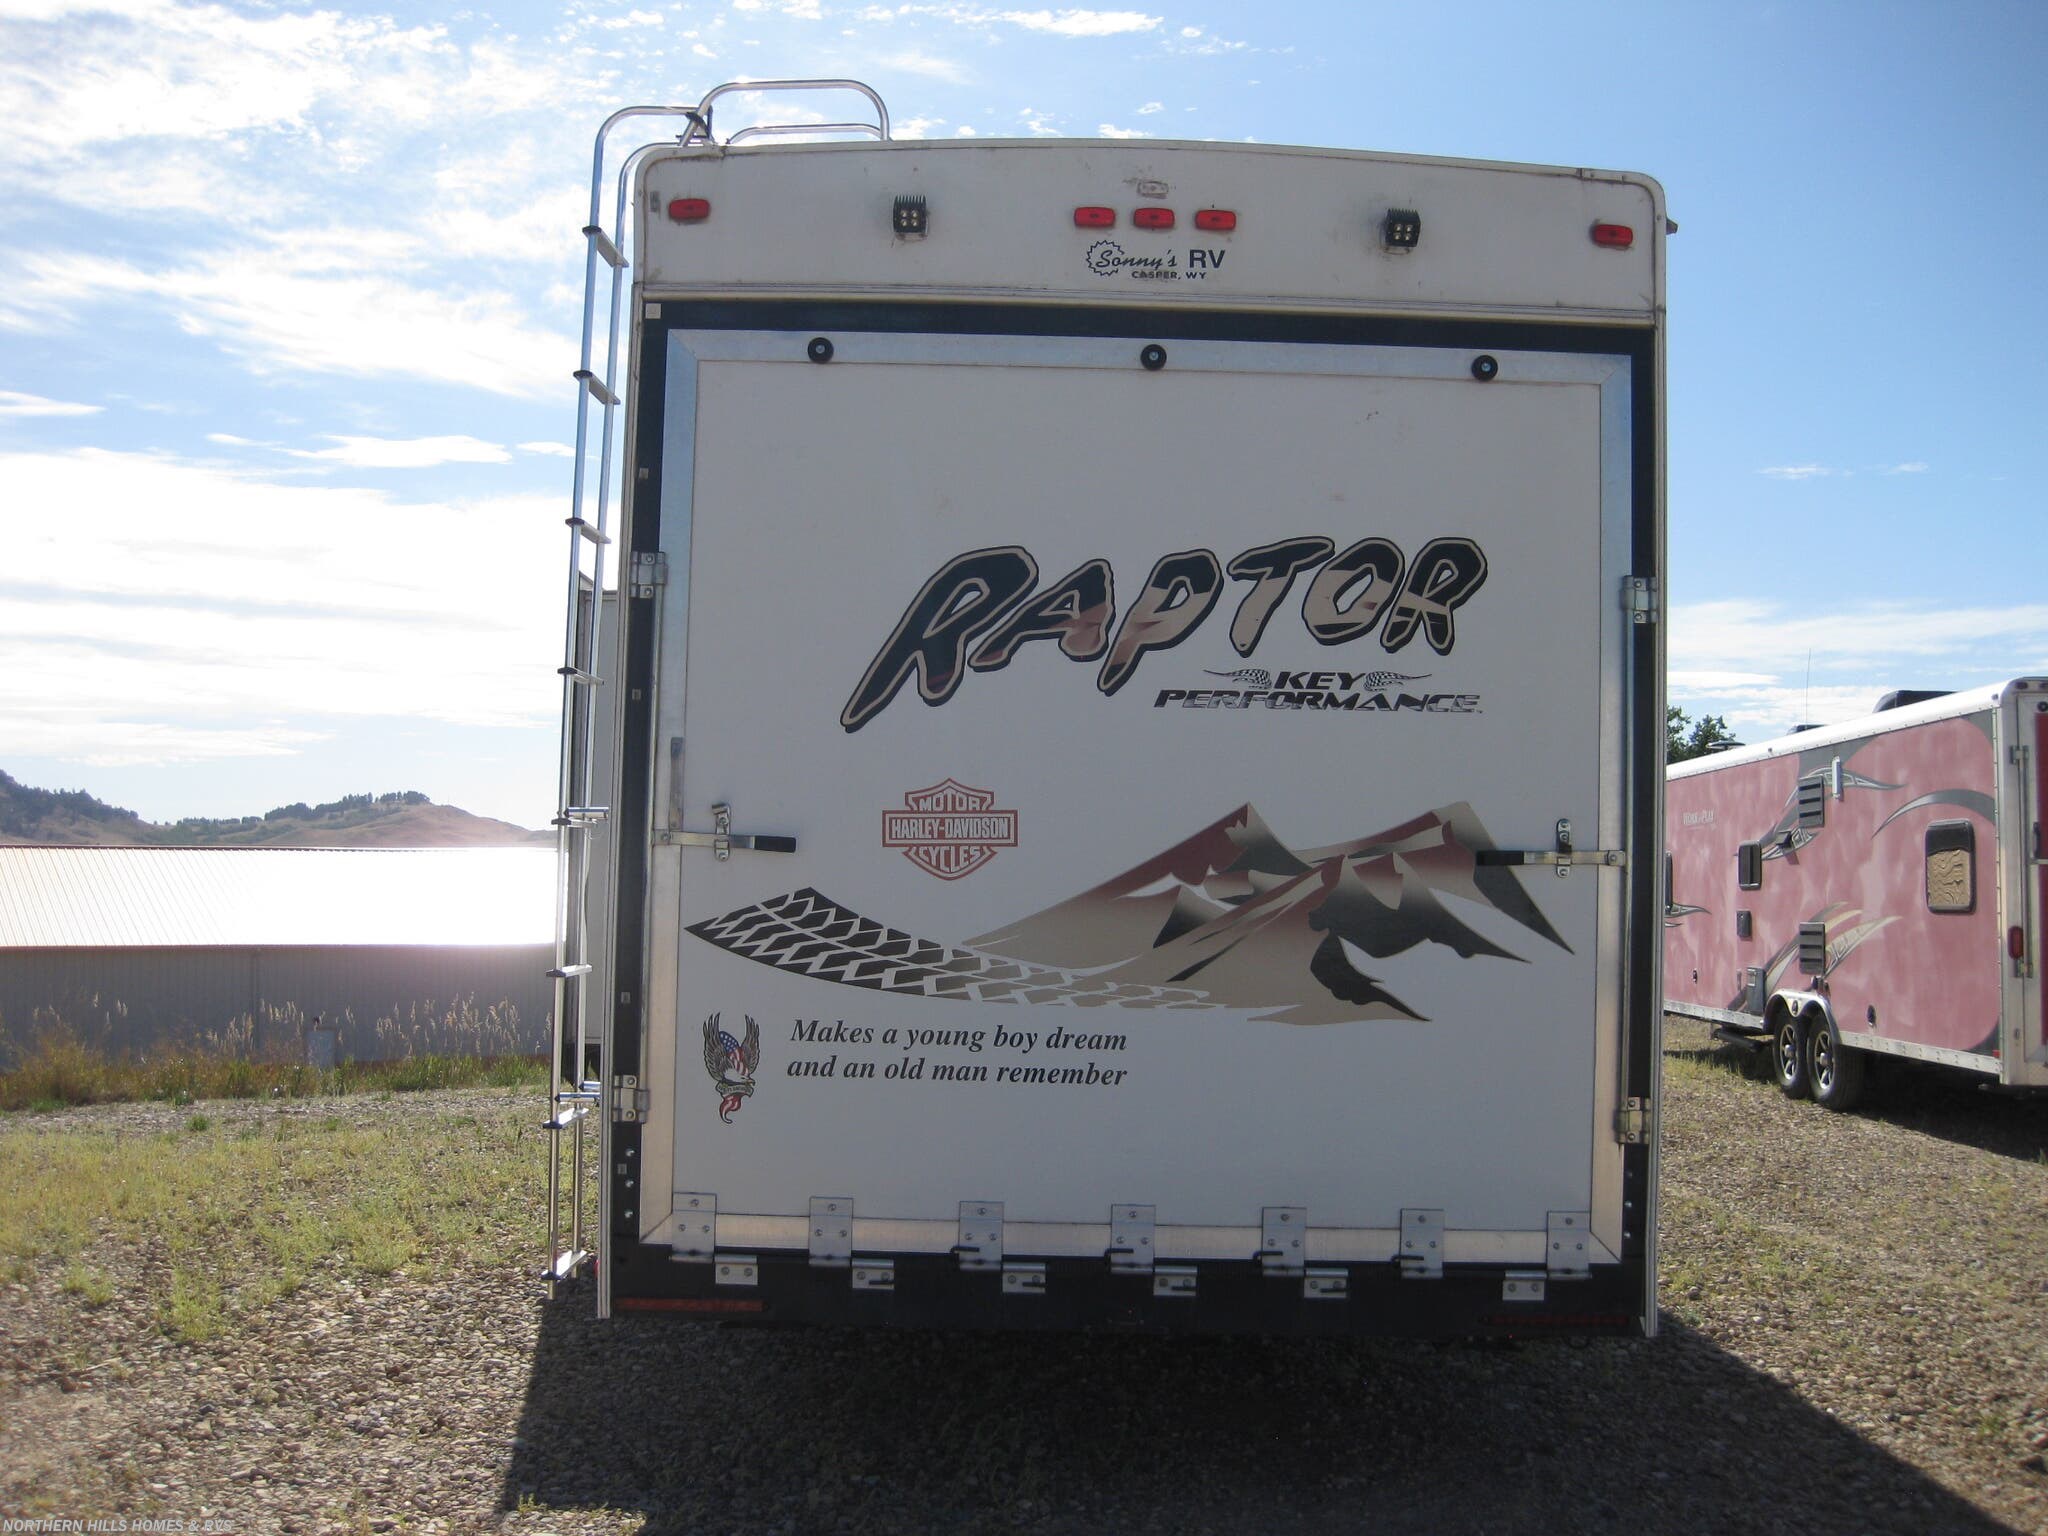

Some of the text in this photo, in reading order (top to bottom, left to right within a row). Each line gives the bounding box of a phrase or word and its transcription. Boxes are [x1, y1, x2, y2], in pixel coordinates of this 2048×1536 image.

[1096, 249, 1226, 270] Sonny's RV
[1131, 270, 1207, 281] CASPER, WY
[839, 535, 1488, 733] RAPTOR
[1271, 671, 1366, 690] KEY
[1153, 689, 1481, 713] PERFORMANCE
[918, 791, 982, 811] MOTOR
[891, 817, 1009, 839] HARLEY-DAVIDSON
[918, 846, 981, 873] CYCLES
[790, 1018, 1127, 1054] Makes a young boy dream
[787, 1054, 1128, 1086] and an old man remember
